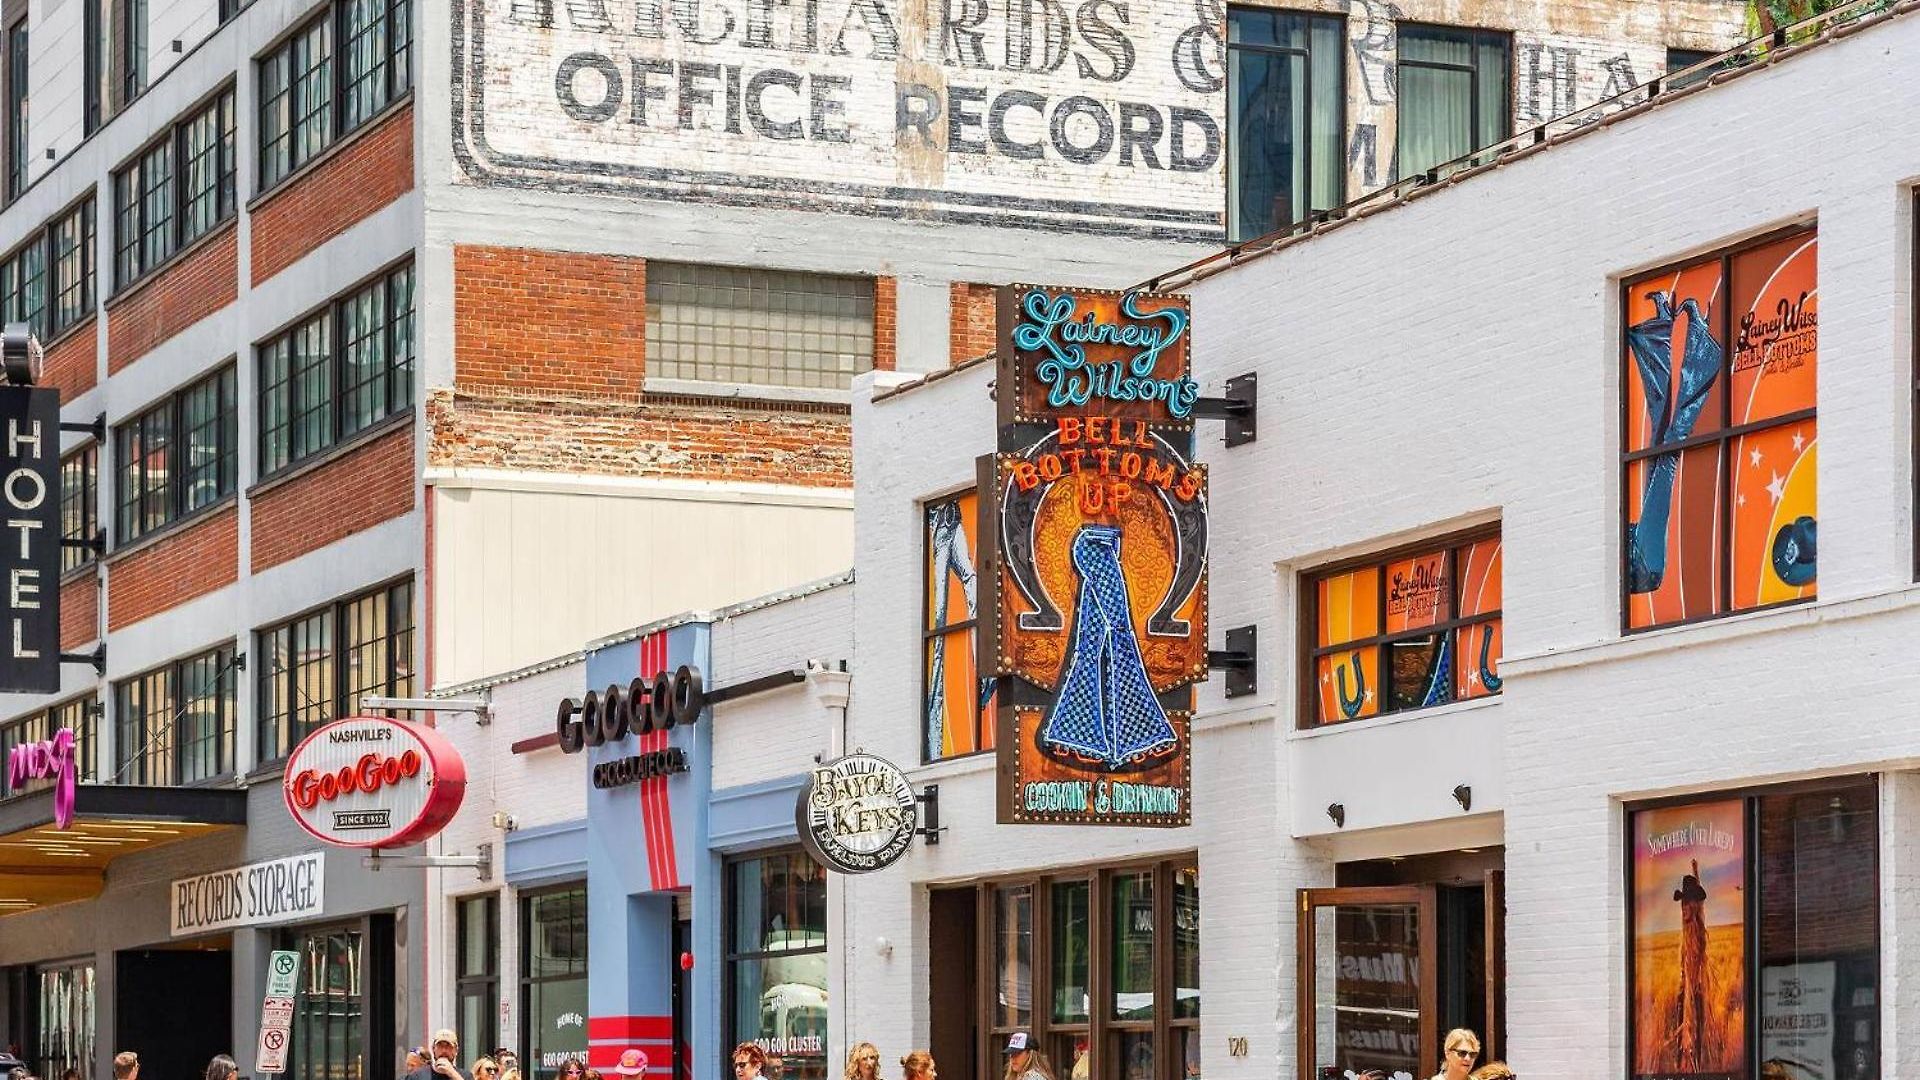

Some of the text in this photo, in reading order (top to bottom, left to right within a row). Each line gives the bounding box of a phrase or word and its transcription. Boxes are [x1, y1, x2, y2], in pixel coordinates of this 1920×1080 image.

[555, 50, 853, 144] OFFICE
[1013, 289, 1186, 377] Lainey
[1737, 311, 1782, 352] Lainey
[1037, 358, 1198, 420] Wilson's
[1057, 416, 1155, 449] BELL
[1013, 447, 1202, 501] BOTTOMS
[1081, 481, 1132, 517] UP
[4, 418, 46, 659] HOTEL
[329, 728, 392, 744] NASHVILLE'S
[292, 750, 421, 811] GooGoo
[812, 767, 896, 809] BAYOU
[1024, 781, 1092, 812] COOKIN'
[1095, 779, 1111, 814] &
[338, 814, 366, 826] SINCE
[816, 808, 916, 867] DUELING PIANOS
[834, 801, 901, 836] KEYS
[176, 858, 317, 929] RECORDS STORAGE
[789, 1035, 821, 1052] CLUSTER
[1228, 1037, 1248, 1056] 120
